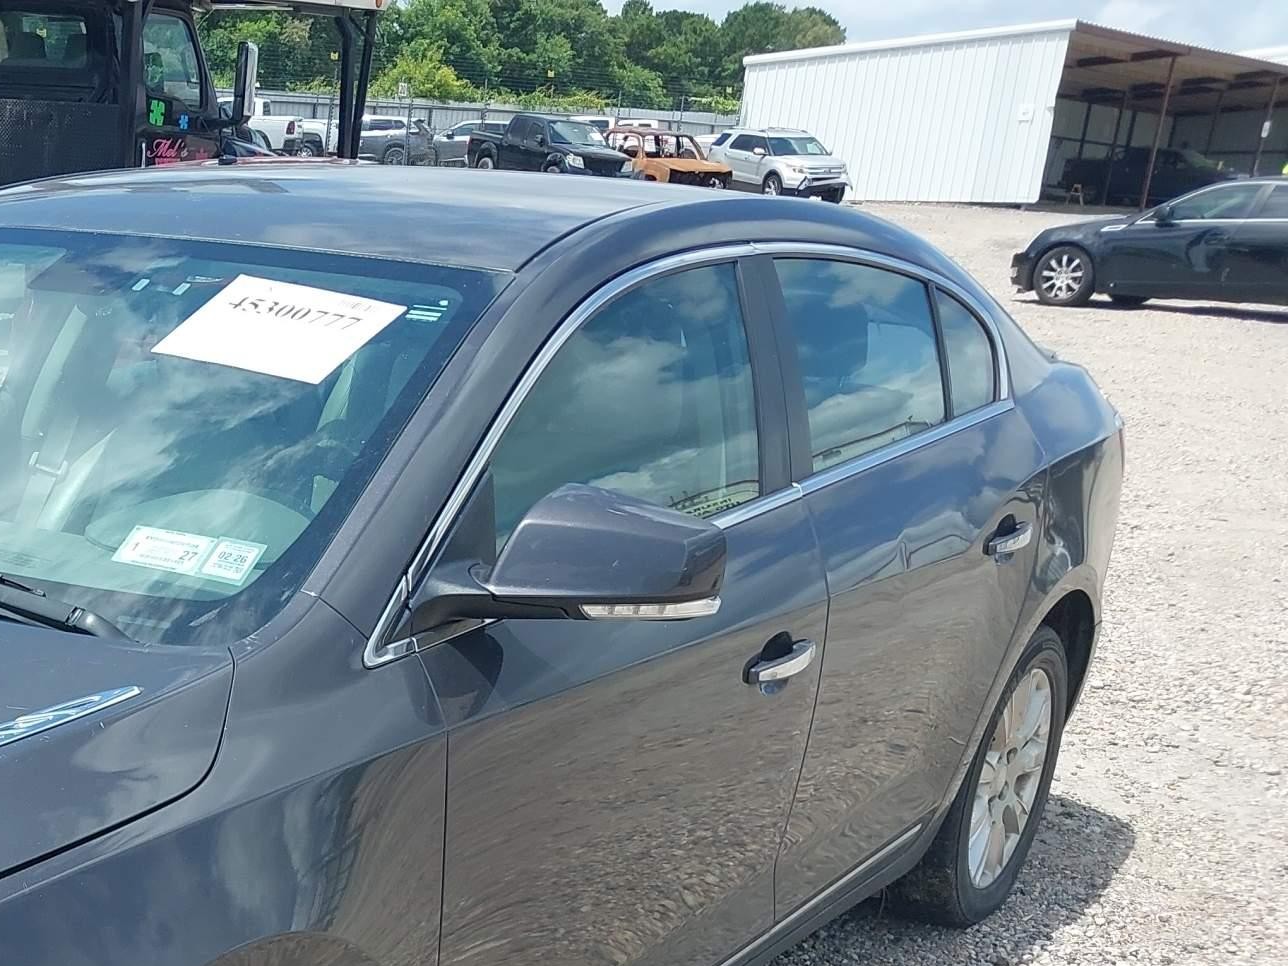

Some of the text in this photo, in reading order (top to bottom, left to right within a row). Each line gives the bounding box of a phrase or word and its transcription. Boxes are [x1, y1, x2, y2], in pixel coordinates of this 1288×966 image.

[147, 138, 189, 157] Mel's
[228, 296, 363, 329] 45300777
[178, 550, 199, 561] 27
